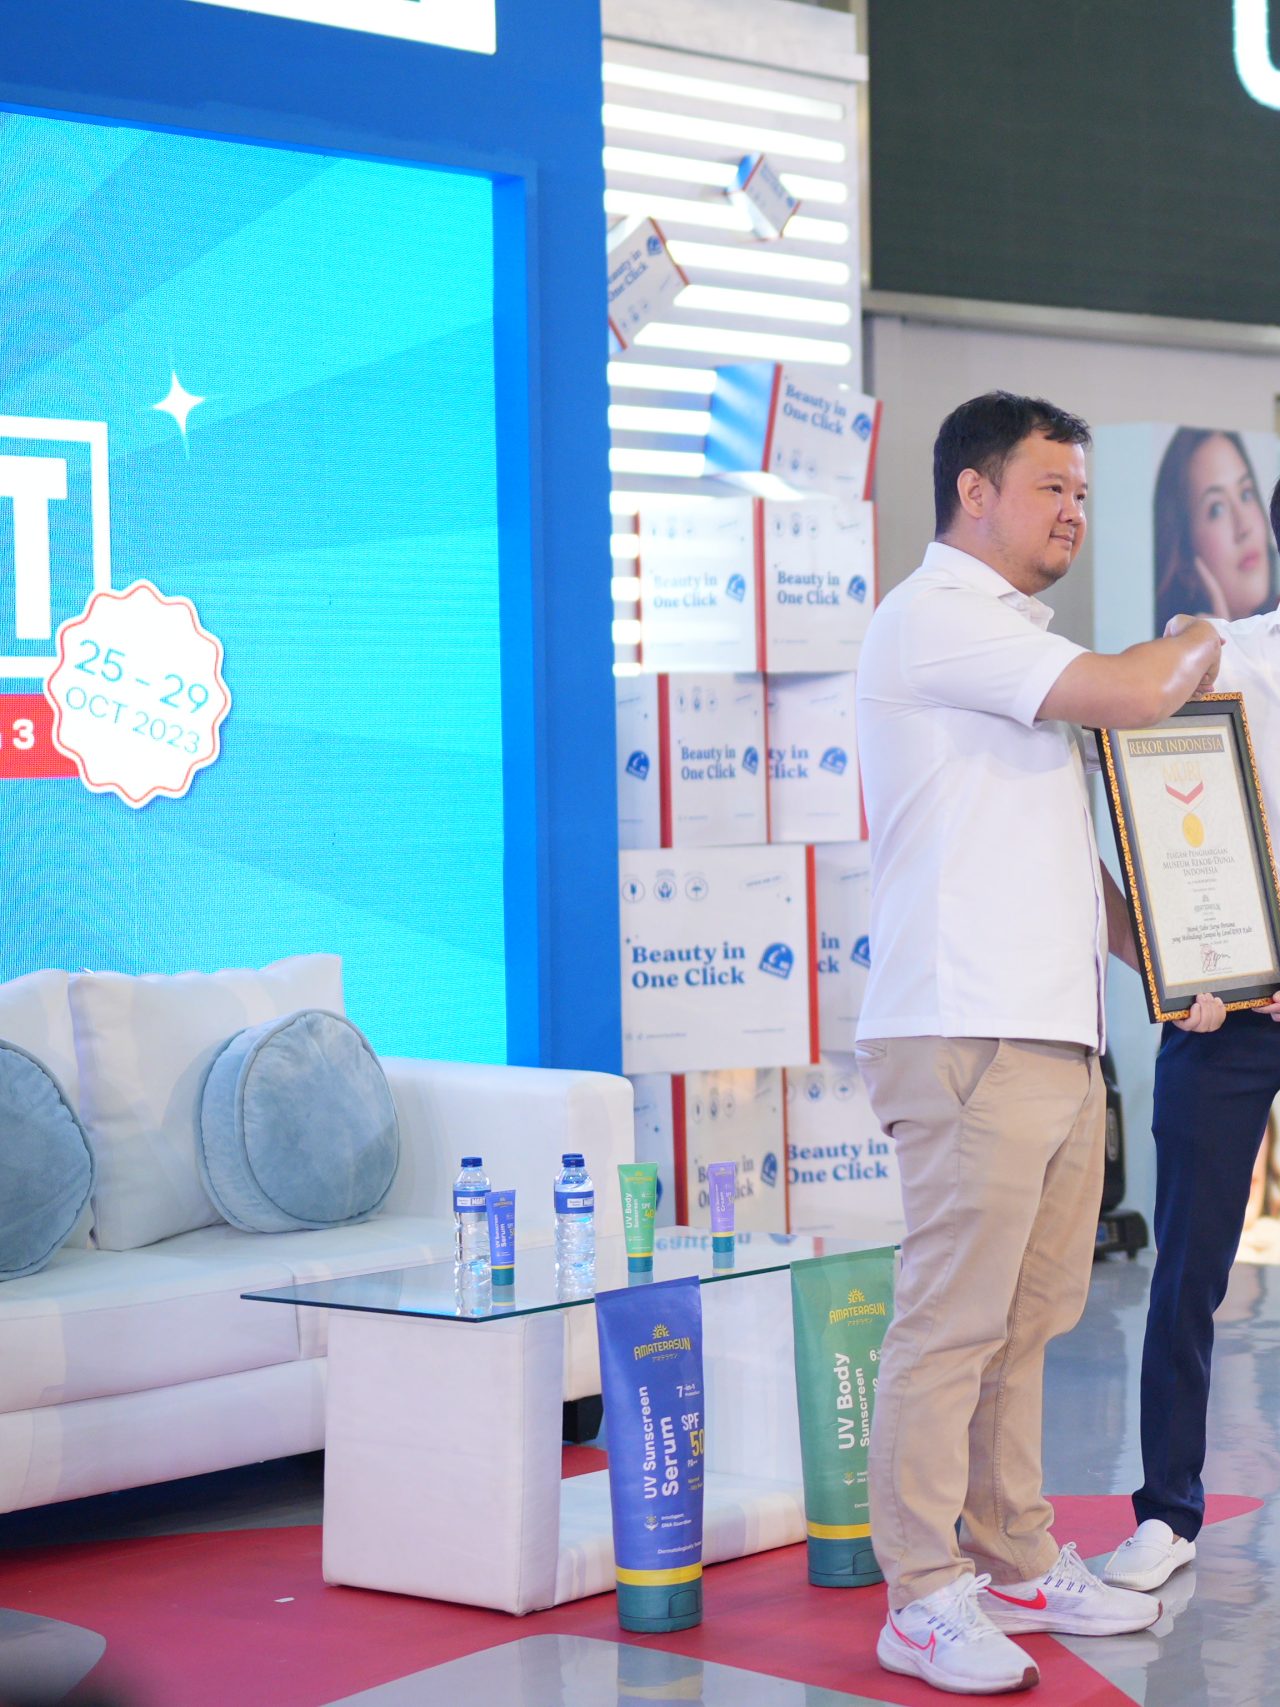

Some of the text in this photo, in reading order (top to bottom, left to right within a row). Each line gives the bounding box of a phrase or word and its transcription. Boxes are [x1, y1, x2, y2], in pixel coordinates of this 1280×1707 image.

[625, 262, 648, 287] Click
[785, 384, 846, 417] Beauty in
[783, 401, 843, 435] One Click
[653, 572, 717, 593] Beauty in
[777, 571, 840, 591] Beauty in
[653, 591, 717, 609] One Click
[777, 590, 840, 606] One Click
[74, 639, 126, 682] 25
[159, 673, 210, 714] 29
[65, 686, 201, 755] OCT 2023
[681, 744, 736, 762] Beauty in
[790, 745, 809, 759] in
[1129, 737, 1224, 755] REKOR INDONESIA
[681, 763, 736, 780] One Click
[1183, 866, 1218, 877] INDONESIA
[821, 931, 840, 950] in
[632, 941, 746, 966] Beauty in
[632, 970, 679, 989] One
[684, 965, 746, 987] Click
[867, 1138, 889, 1155] in
[832, 1161, 889, 1181] Click
[624, 1193, 632, 1229] UV Body
[829, 1302, 886, 1324] AMATERASUN
[634, 1337, 692, 1361] AMATERASUN
[834, 1352, 855, 1450] UV Body
[856, 1367, 870, 1448] Sunscreen
[681, 1412, 700, 1431] SPF
[639, 1386, 658, 1499] UV Sunscreen
[690, 1428, 704, 1457] 50
[660, 1416, 680, 1497] Serum
